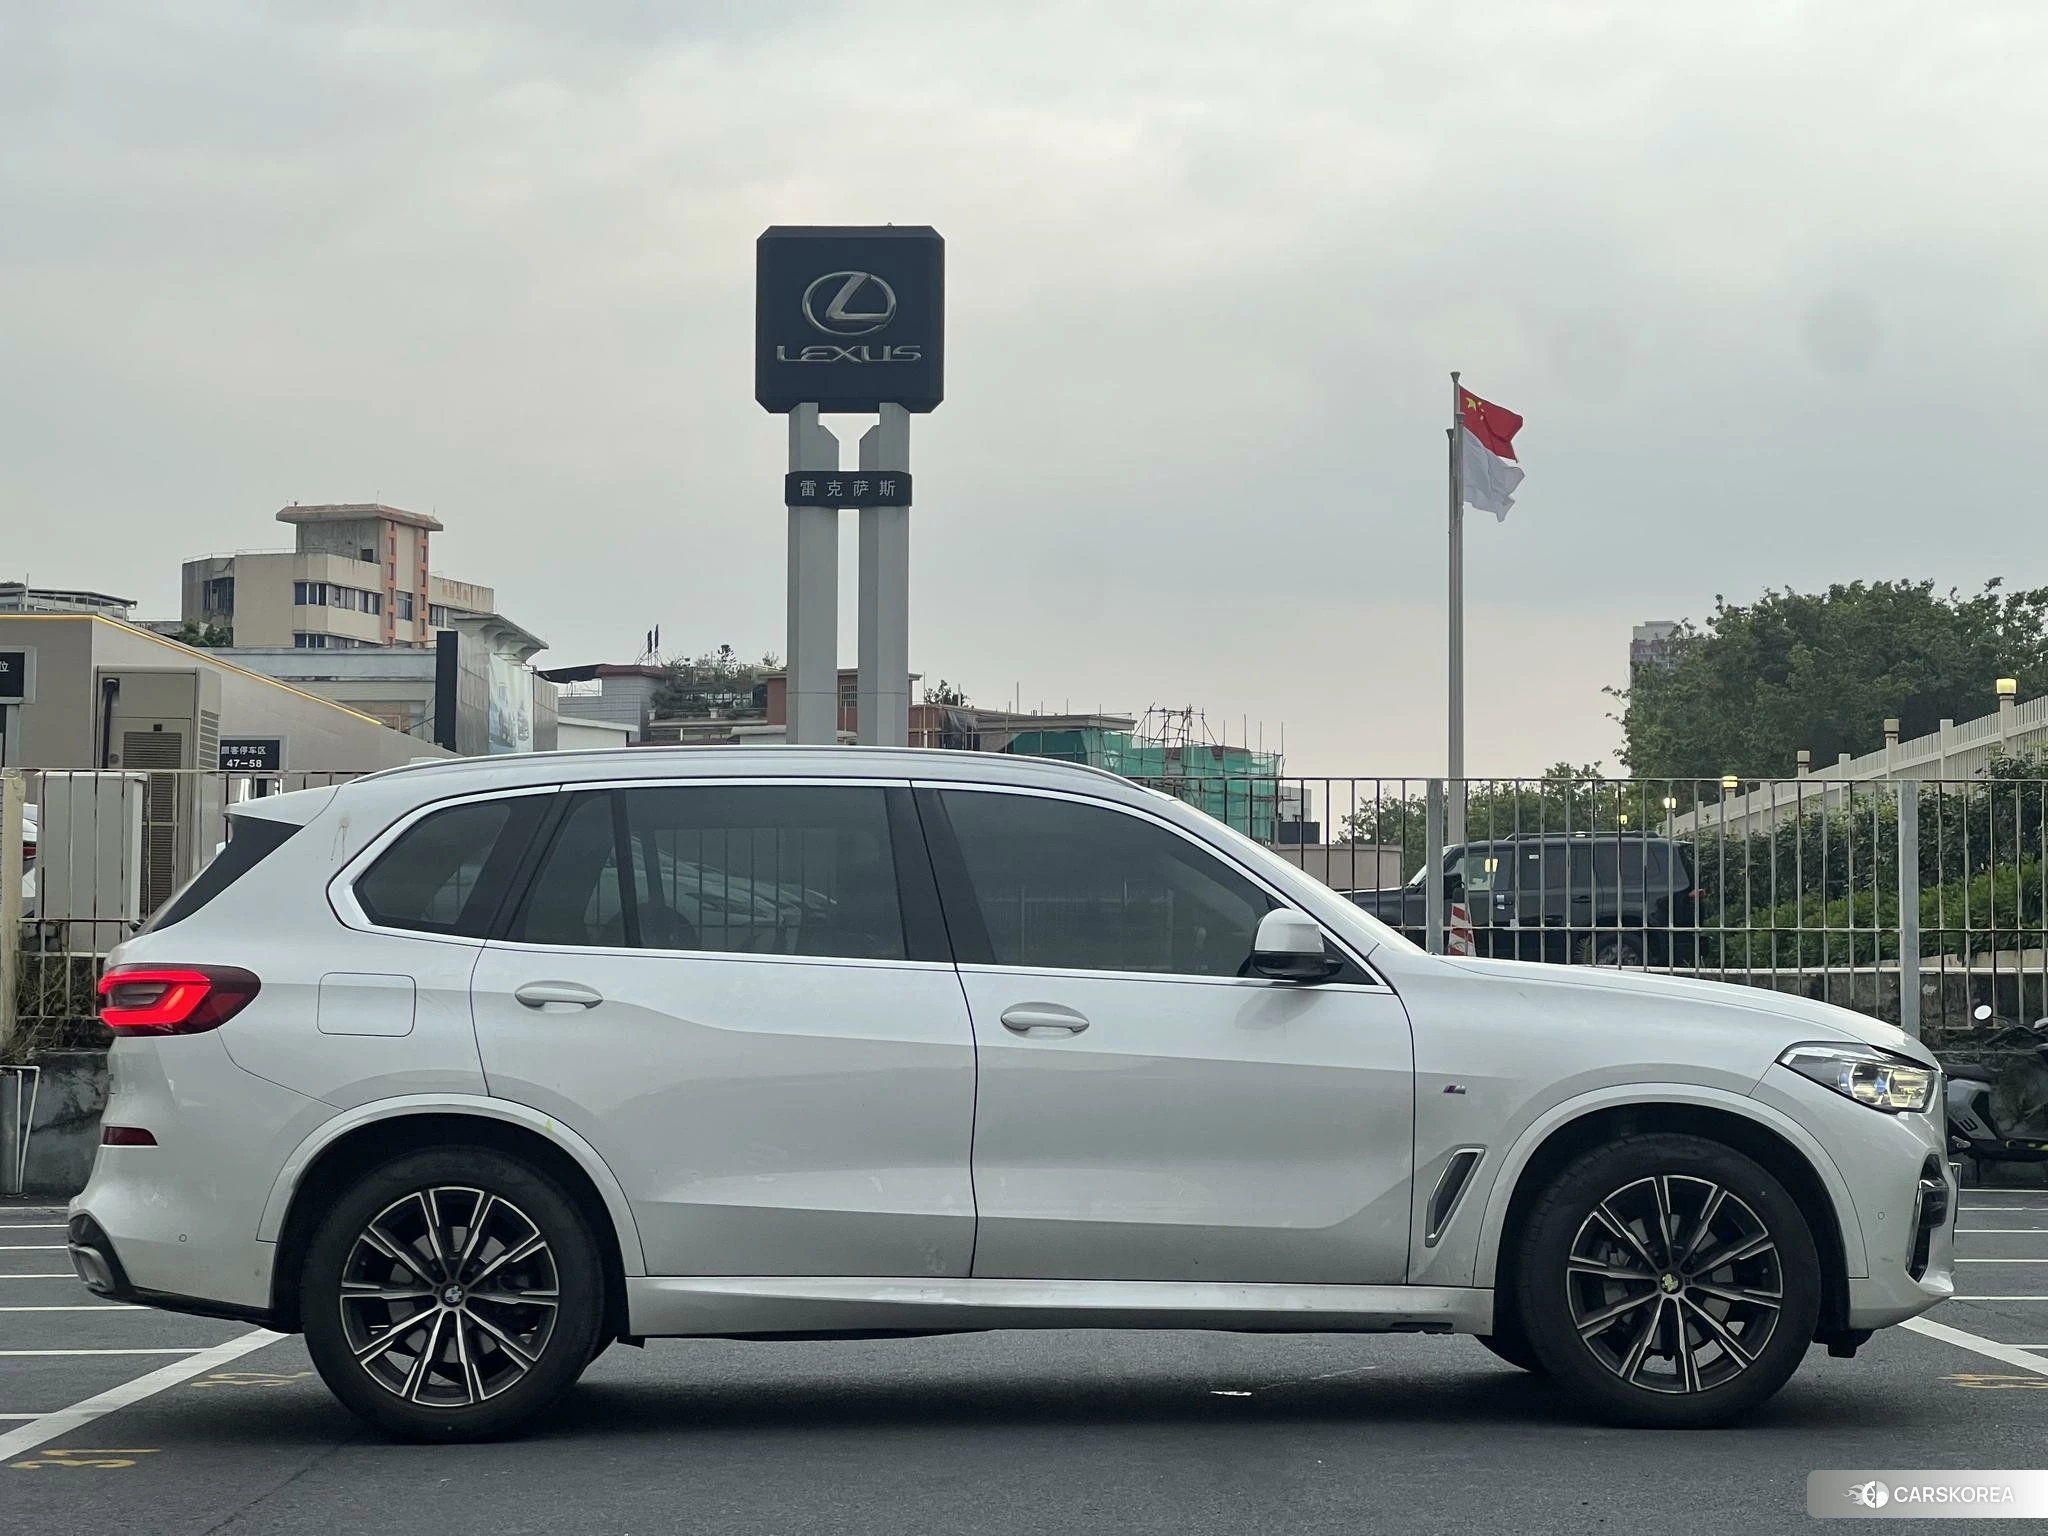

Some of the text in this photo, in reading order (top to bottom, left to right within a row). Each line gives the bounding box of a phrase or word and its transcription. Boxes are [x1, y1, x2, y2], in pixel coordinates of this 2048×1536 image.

[776, 345, 922, 362] LEXUS
[800, 480, 896, 497] 雷克萨斯
[226, 759, 262, 768] 47-58
